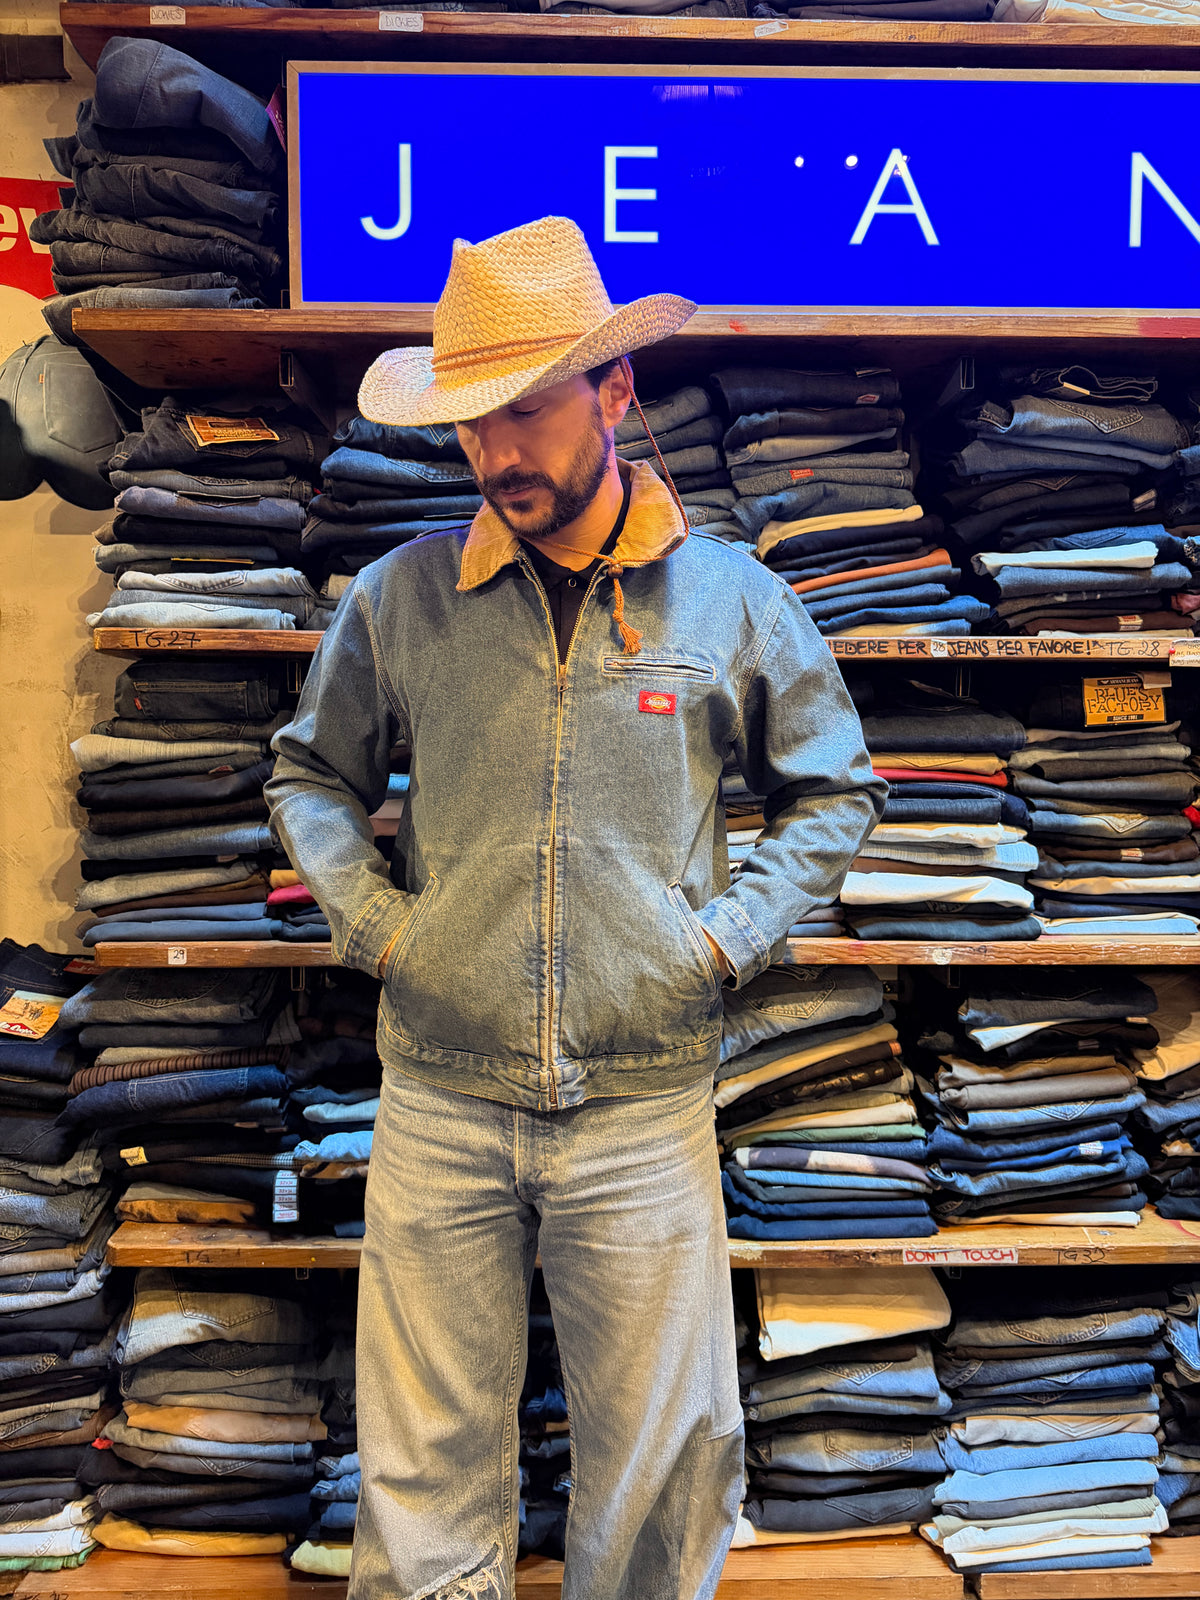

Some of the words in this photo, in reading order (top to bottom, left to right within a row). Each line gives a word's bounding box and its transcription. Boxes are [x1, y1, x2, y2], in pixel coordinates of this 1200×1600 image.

[897, 640, 928, 655] PER
[946, 640, 990, 657] JEANS
[996, 640, 1024, 656] PER
[1027, 640, 1092, 656] FAVORE!
[1087, 695, 1161, 714] FACTORY
[173, 949, 185, 961] 29
[905, 1250, 949, 1263] DON'T
[961, 1249, 1014, 1262] TOUCH
